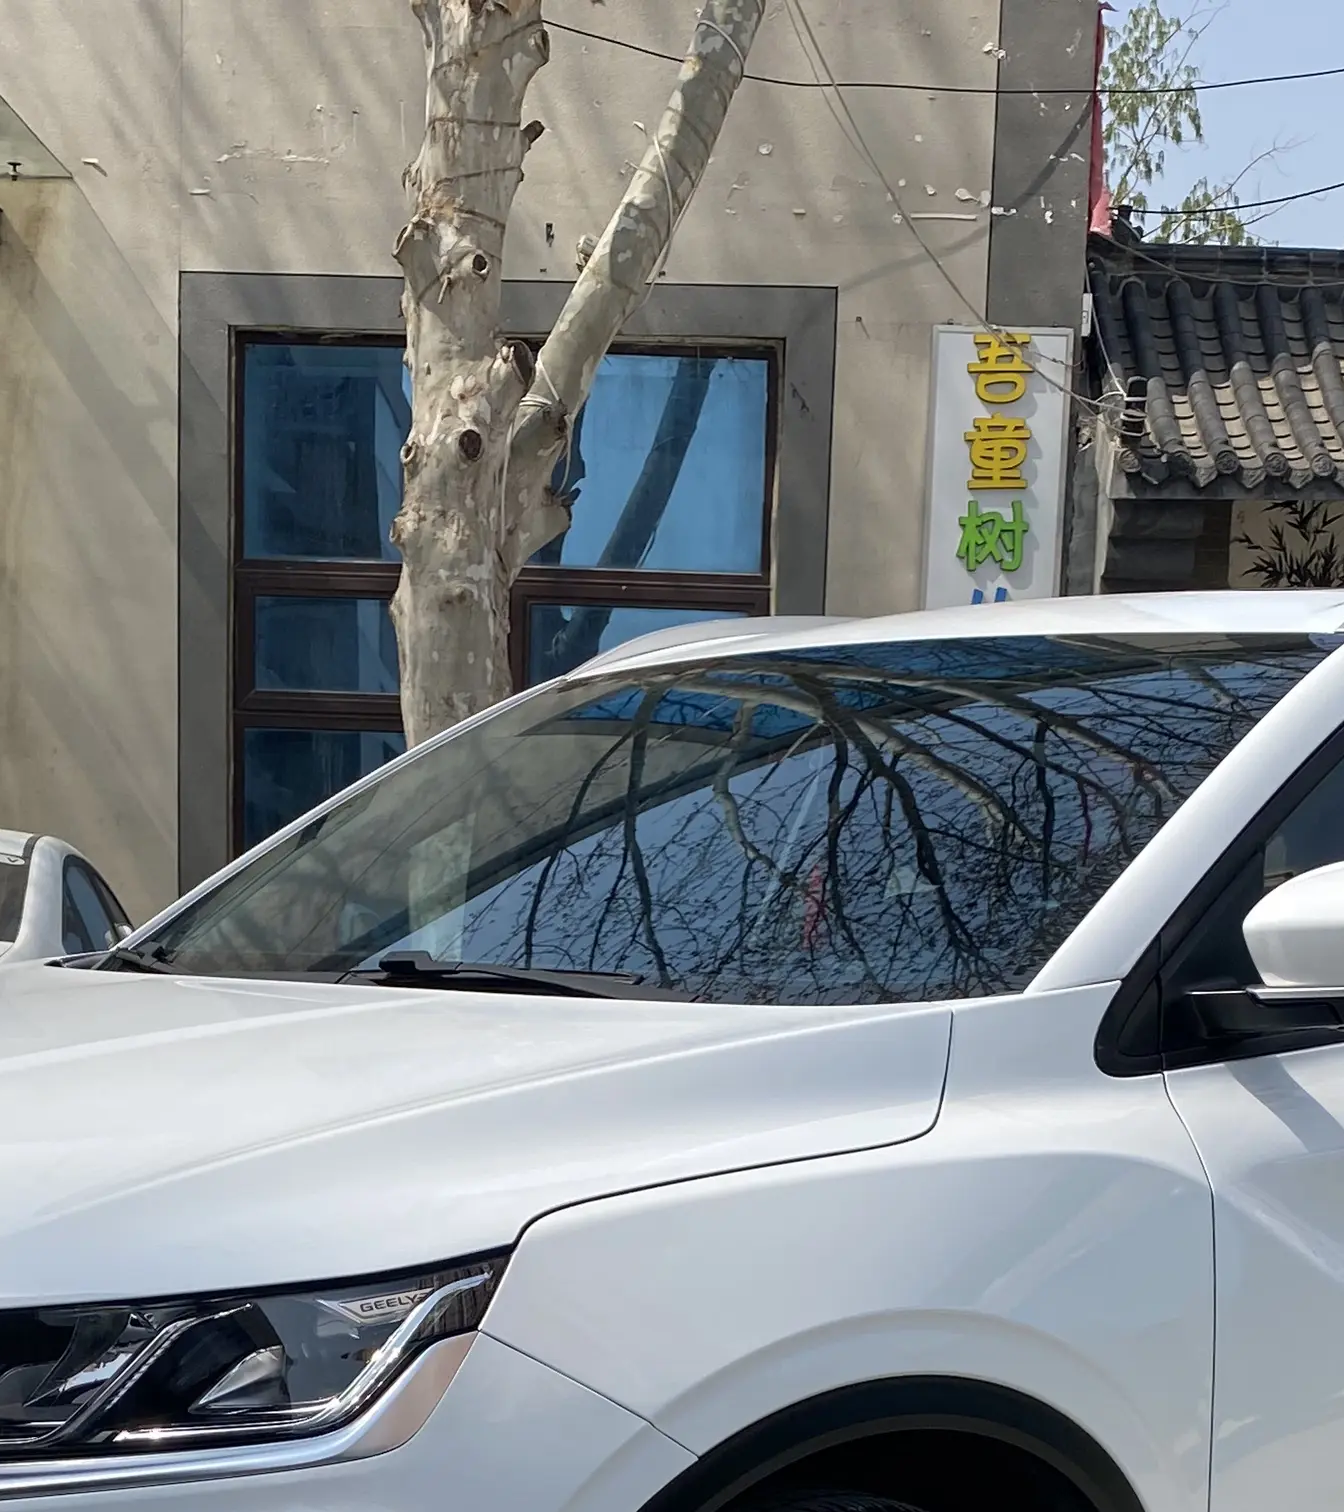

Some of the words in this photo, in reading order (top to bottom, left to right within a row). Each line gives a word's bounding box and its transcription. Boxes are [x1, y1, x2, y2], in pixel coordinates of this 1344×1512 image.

[956, 333, 1035, 605] 吾童树
[360, 1293, 422, 1313] GEELY
